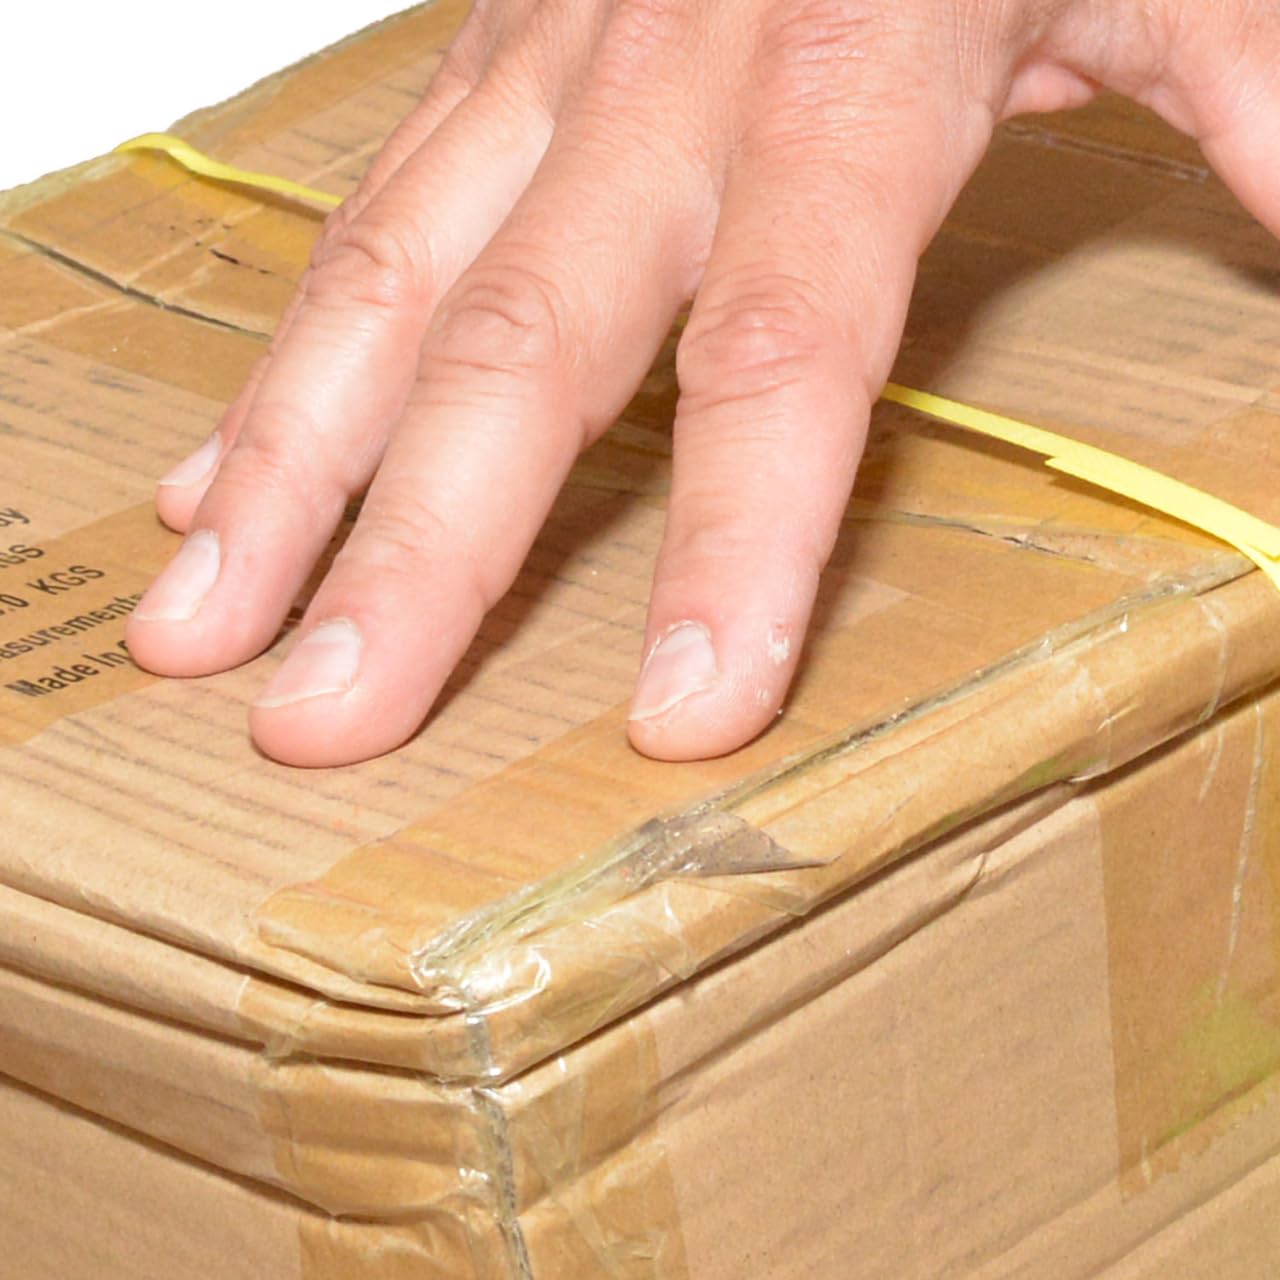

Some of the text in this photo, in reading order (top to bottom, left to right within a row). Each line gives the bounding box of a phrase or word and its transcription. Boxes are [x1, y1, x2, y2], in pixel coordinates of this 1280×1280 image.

[26, 565, 105, 595] KGS
[4, 651, 134, 697] Made In
